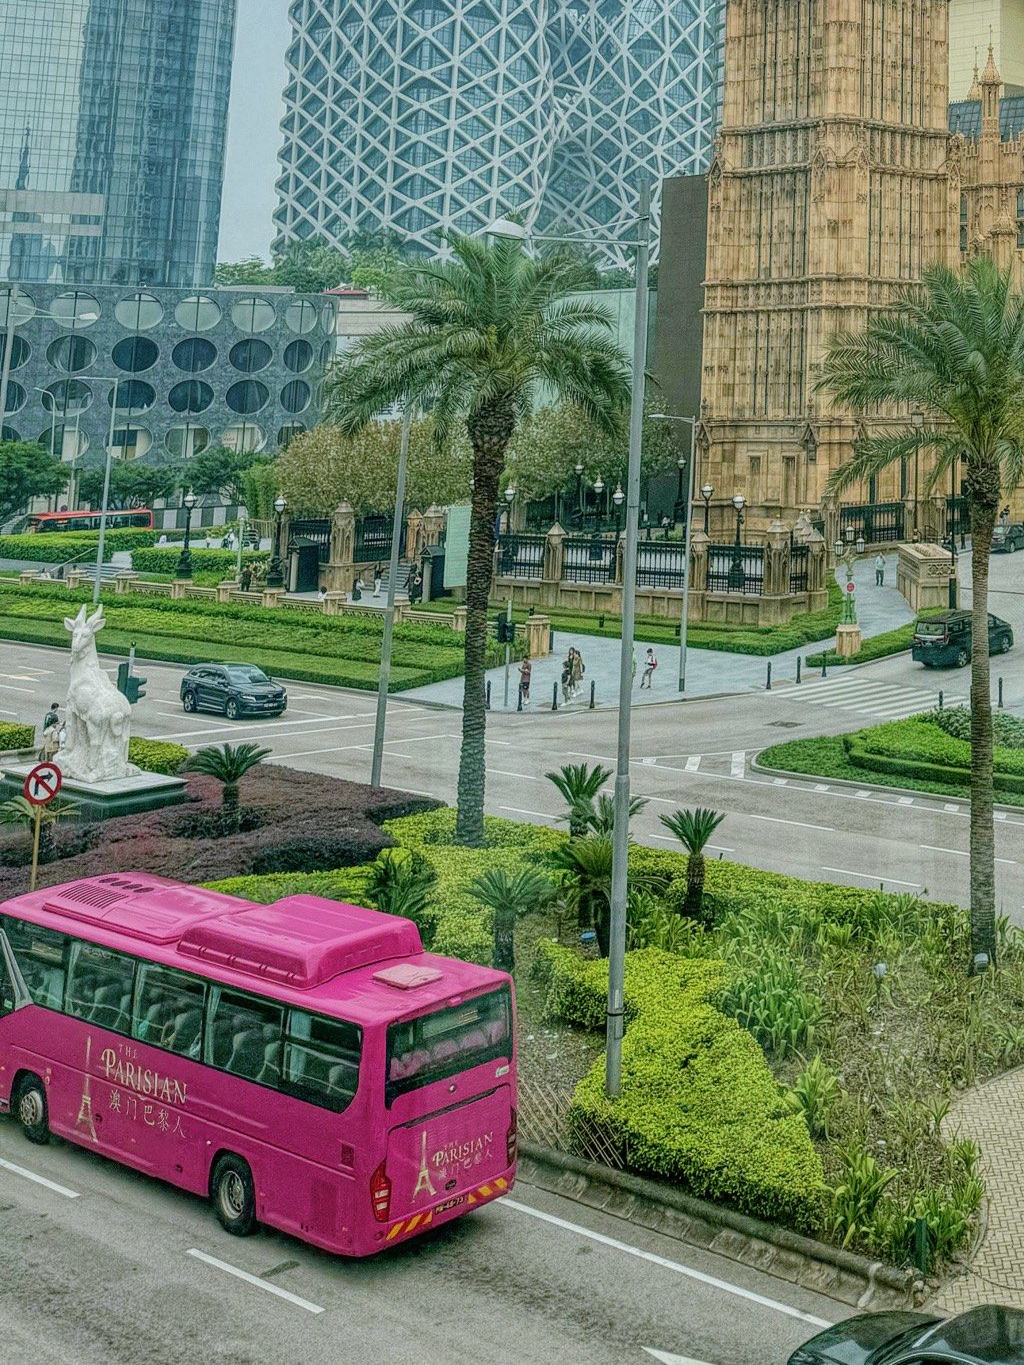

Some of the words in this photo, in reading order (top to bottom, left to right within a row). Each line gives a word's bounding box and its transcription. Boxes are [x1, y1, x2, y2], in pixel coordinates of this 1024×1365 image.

[119, 1044, 137, 1059] THE
[101, 1048, 187, 1104] PARISIAN
[432, 1132, 493, 1167] PARISIAN
